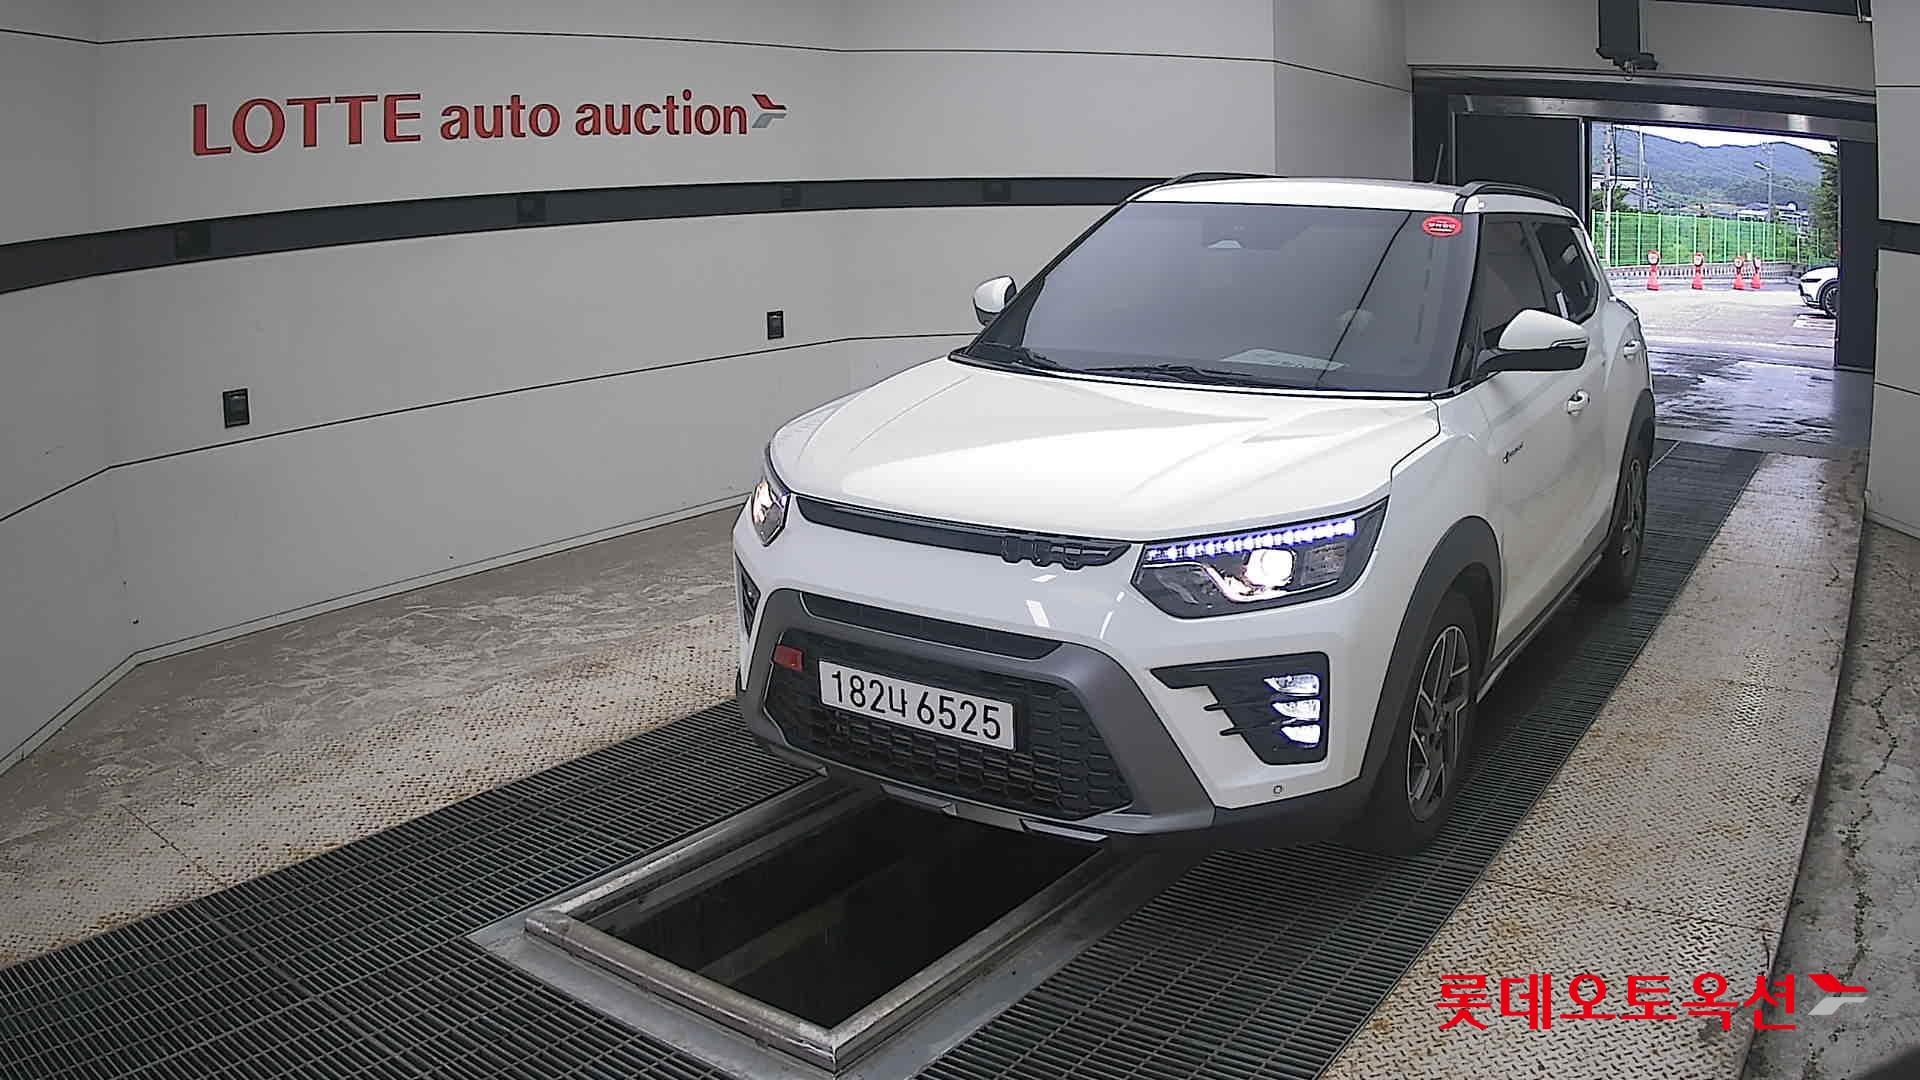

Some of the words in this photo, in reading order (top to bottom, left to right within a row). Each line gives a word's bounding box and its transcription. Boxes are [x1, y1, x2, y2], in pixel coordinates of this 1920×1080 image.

[192, 93, 421, 156] LOTTE
[439, 94, 560, 140] auto
[575, 88, 748, 137] auction
[832, 671, 908, 718] 182나
[916, 691, 1001, 740] 6525
